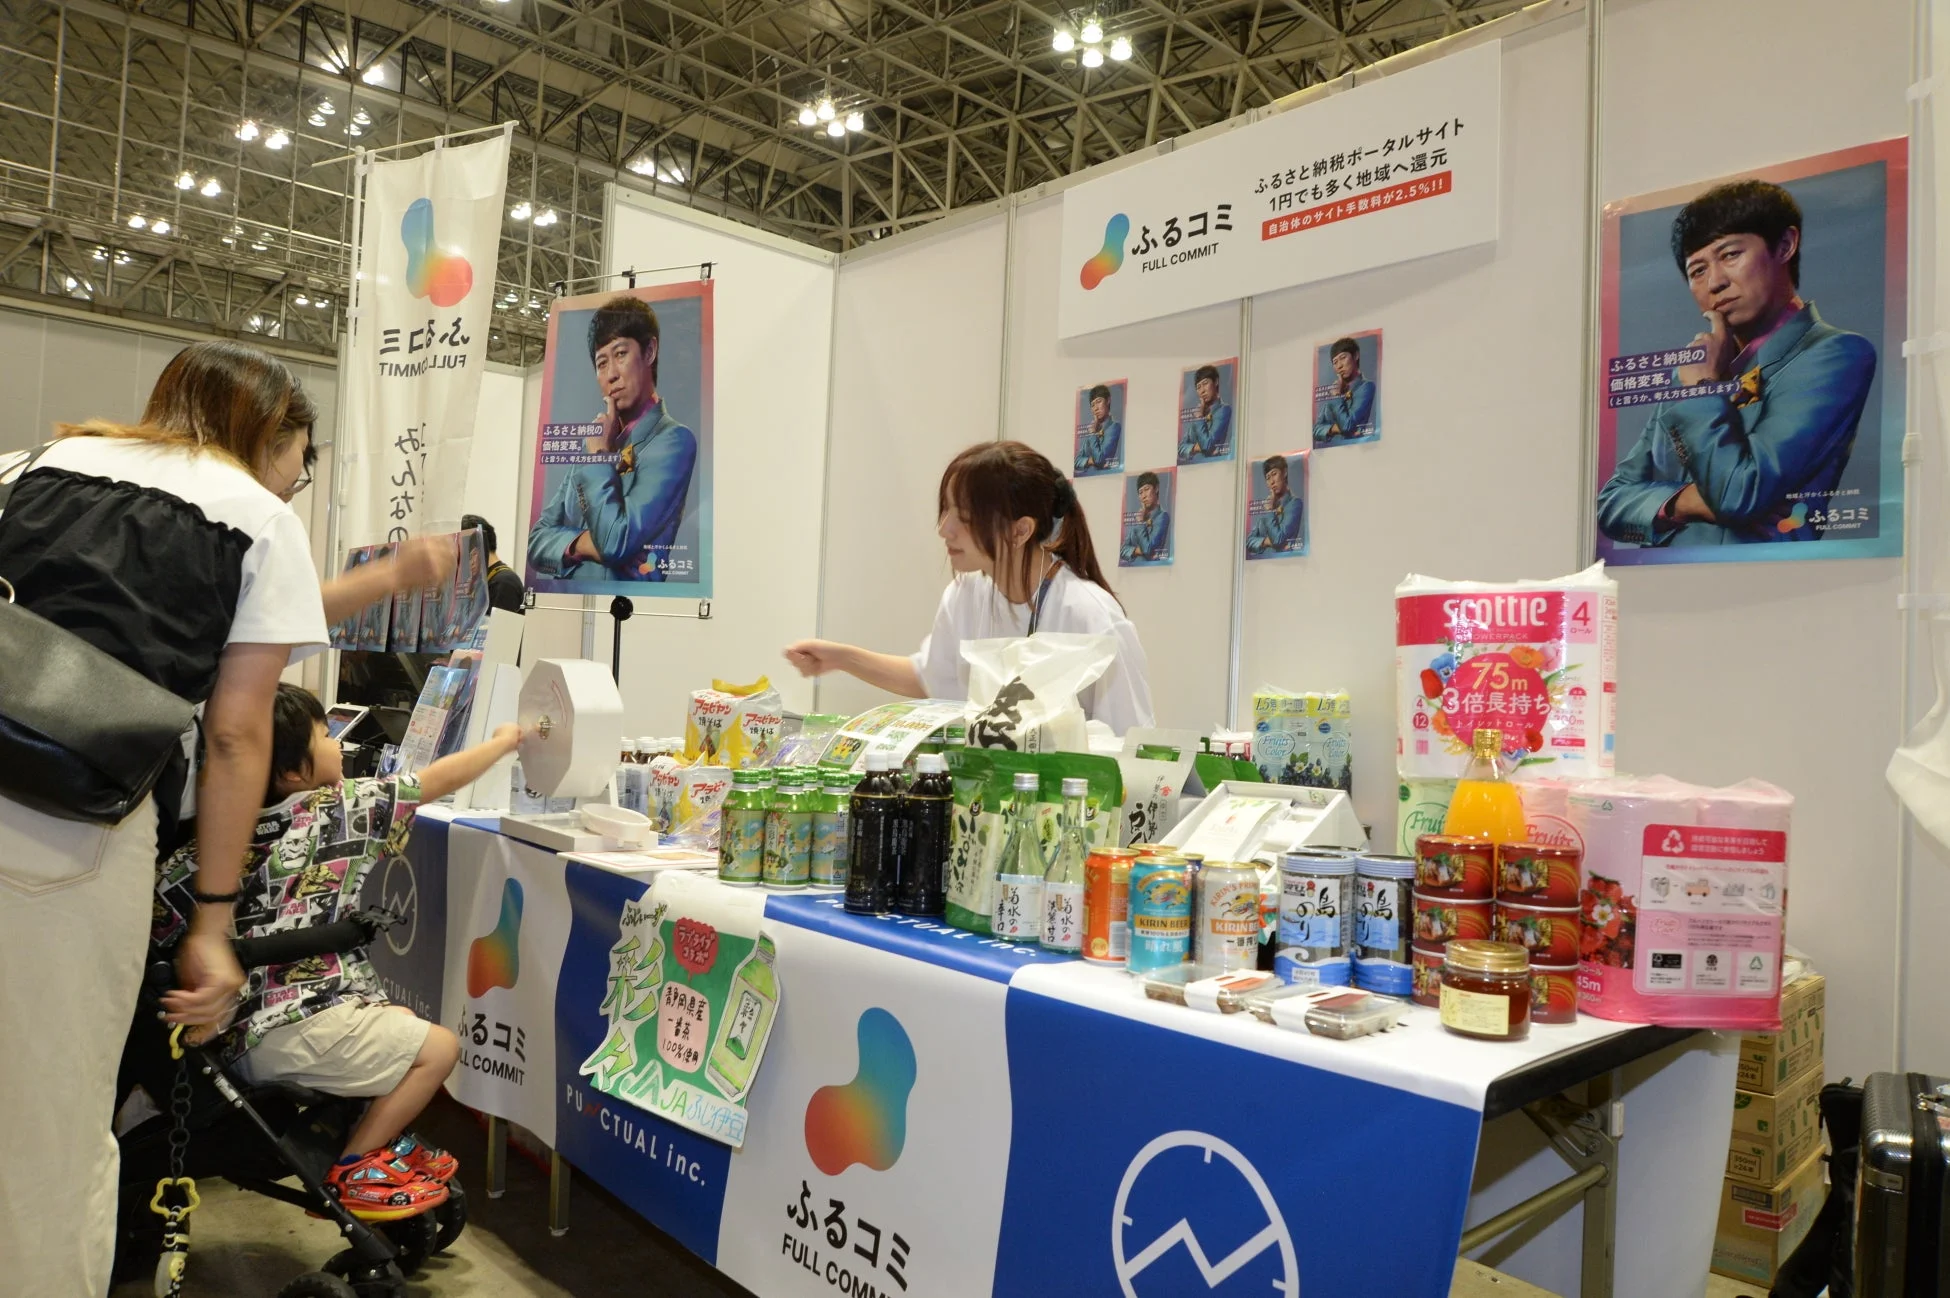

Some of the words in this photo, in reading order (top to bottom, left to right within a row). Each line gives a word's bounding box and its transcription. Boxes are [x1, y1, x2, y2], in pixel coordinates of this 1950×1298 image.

[1255, 118, 1464, 194] ふるさと納税ポータルサイト
[1269, 148, 1448, 212] 1円でも多く地域へ還元
[1268, 178, 1443, 236] 自治体のサイト手数料が2.5%!!
[1131, 203, 1233, 256] ふるコミ
[1142, 256, 1167, 273] FULL
[1170, 242, 1219, 266] COMMIT
[1610, 349, 1705, 373] ふるさと納税の
[1610, 373, 1671, 392] 価格変革。
[543, 424, 603, 436] ふるさと納税の
[542, 440, 582, 451] 価格変革。
[1809, 507, 1869, 523] ふるコミ
[657, 559, 694, 569] ふるコミ
[1571, 601, 1591, 627] 4
[1471, 662, 1528, 691] 75m
[1442, 687, 1551, 715] 3倍長持ち
[1416, 715, 1427, 727] 12
[1263, 735, 1289, 746] Fruits
[1265, 746, 1288, 757] Color
[257, 820, 280, 831] STAR
[1140, 918, 1168, 929] KIRIN
[1215, 921, 1247, 932] KIRIN
[665, 985, 707, 1022] 静岡県産
[662, 1038, 699, 1066] 100%使用
[472, 1054, 525, 1086] COMMIT
[566, 1083, 657, 1160] PUNCTUAL
[666, 1143, 706, 1187] inc.
[787, 1180, 911, 1292] ふるコミ
[782, 1233, 821, 1276] FULL
